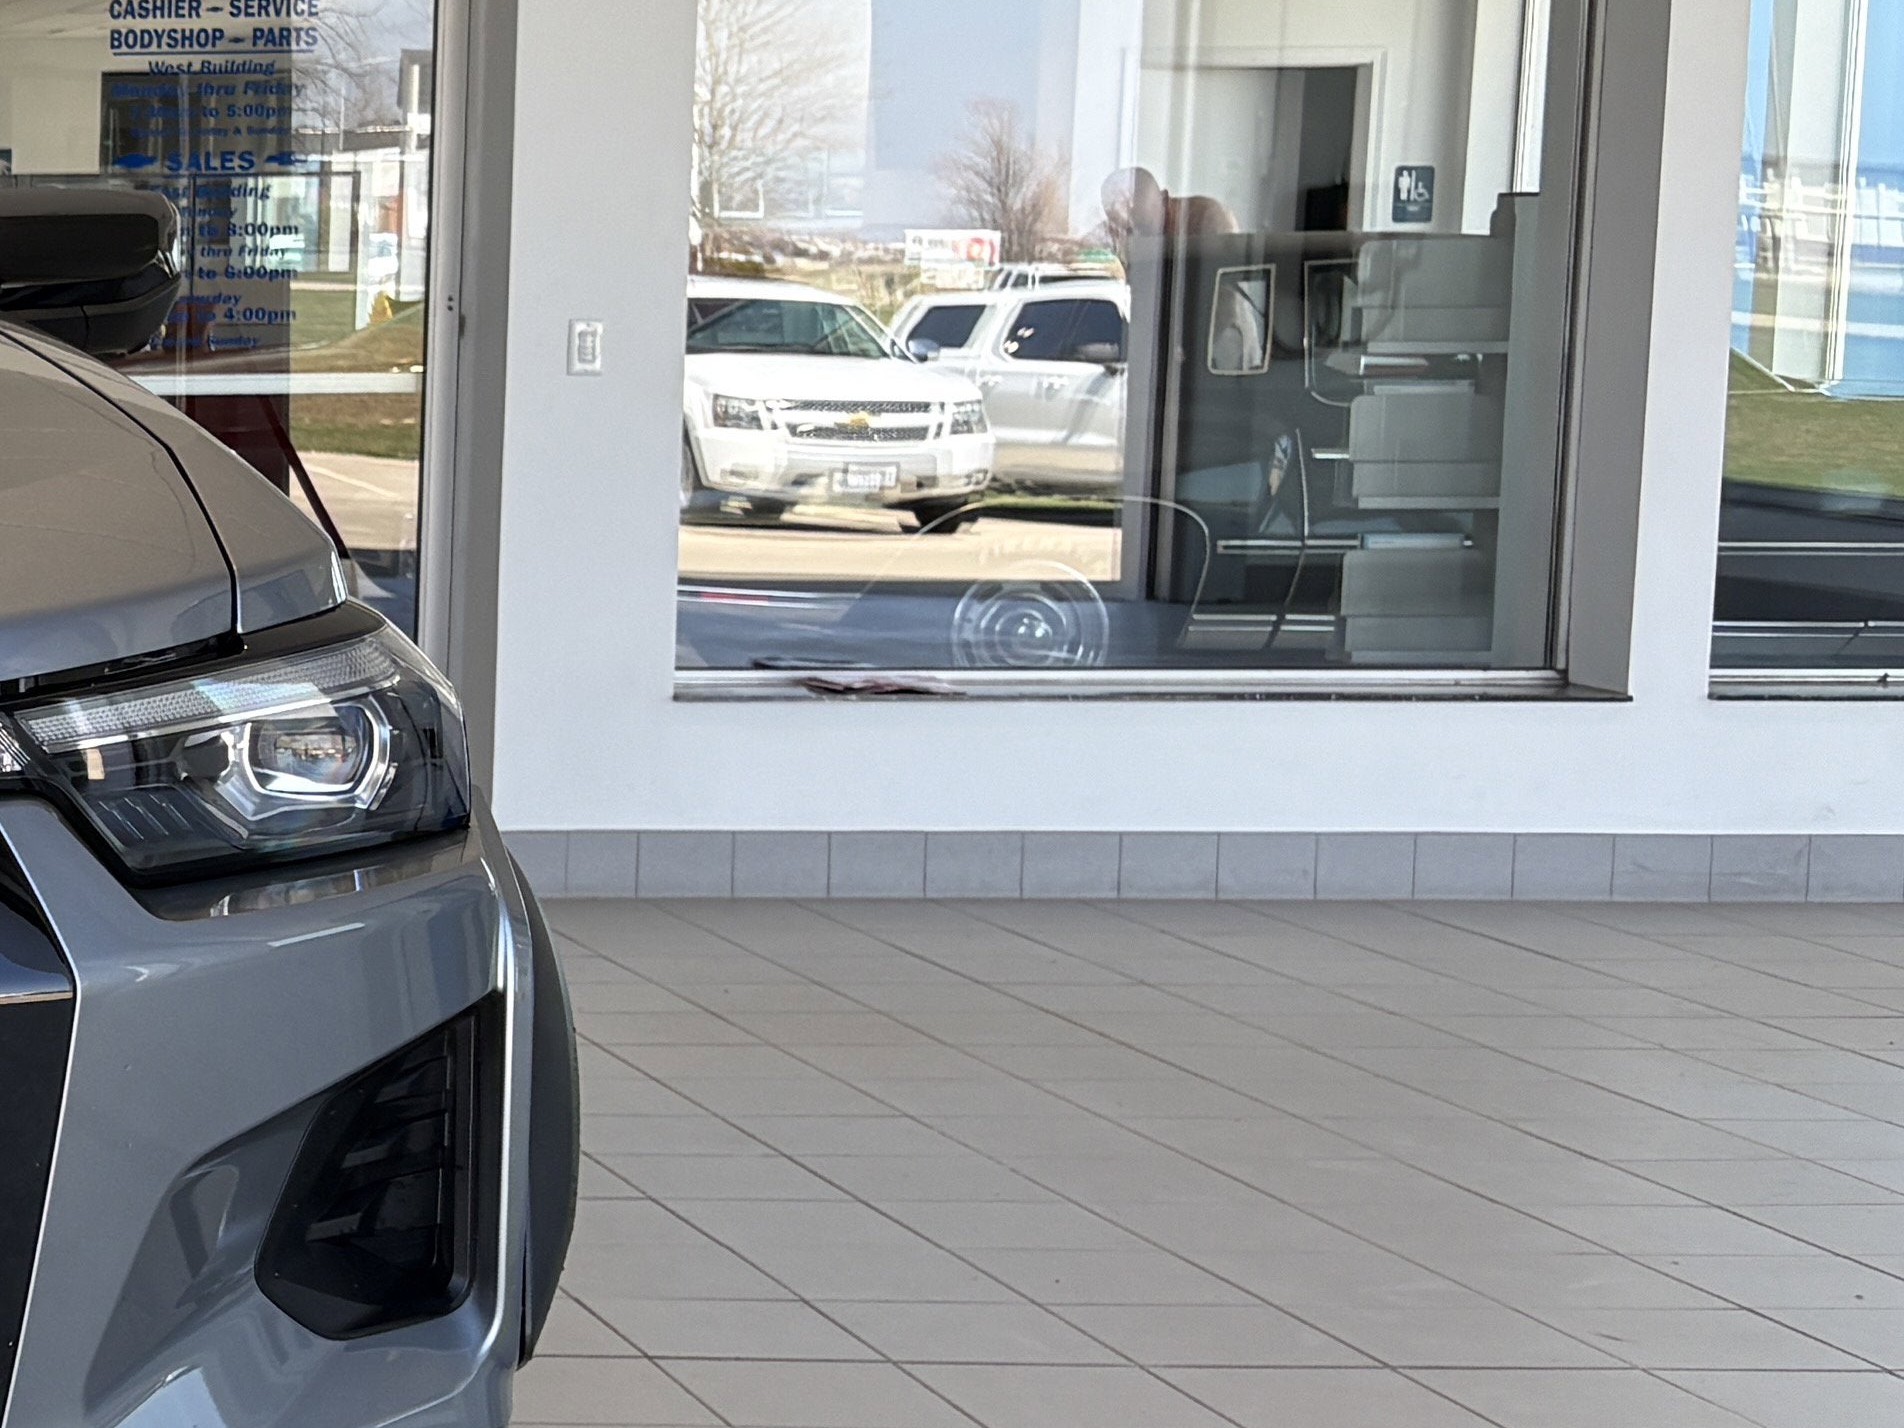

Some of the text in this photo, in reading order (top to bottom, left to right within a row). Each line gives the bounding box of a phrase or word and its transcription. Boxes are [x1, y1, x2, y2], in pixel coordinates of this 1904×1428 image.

[110, 26, 319, 50] BODYSHOP PARTS
[148, 59, 275, 76] West Building
[197, 82, 236, 96] thru
[202, 106, 220, 118] to
[166, 151, 256, 172] SALES
[198, 266, 217, 280] to
[224, 307, 296, 325] 4:00pm
